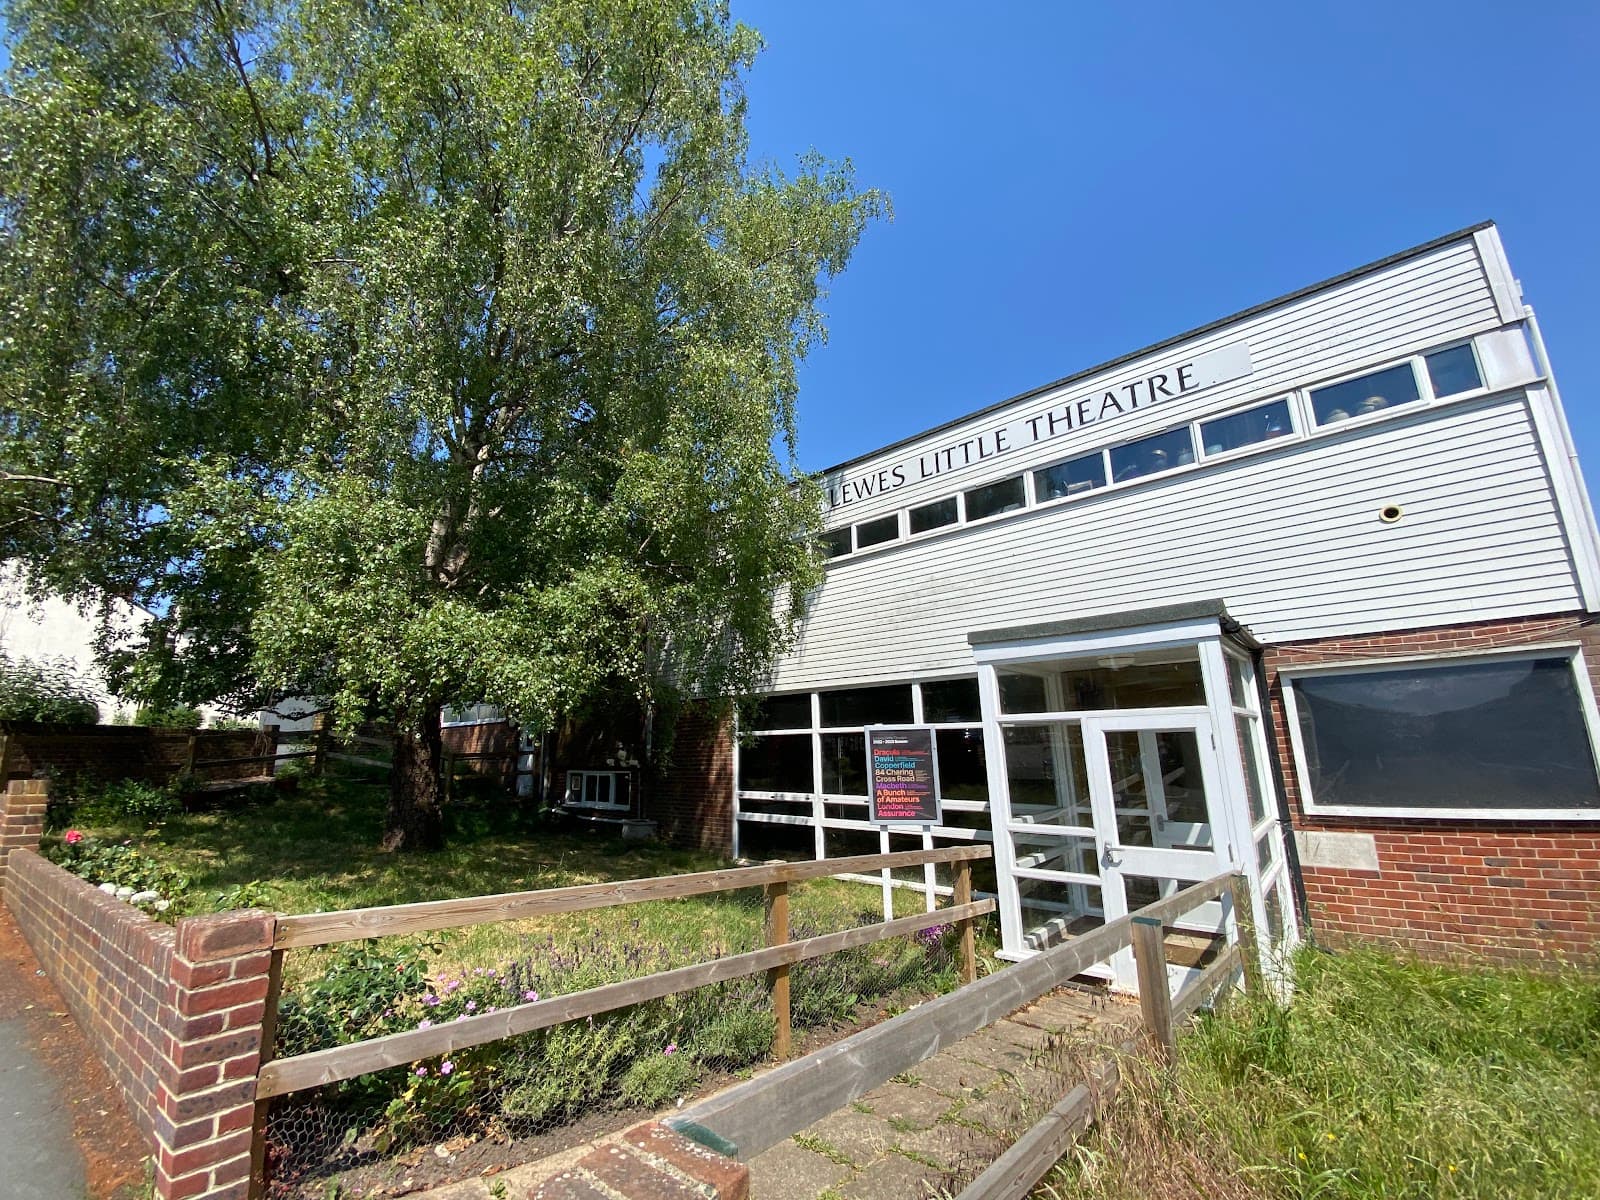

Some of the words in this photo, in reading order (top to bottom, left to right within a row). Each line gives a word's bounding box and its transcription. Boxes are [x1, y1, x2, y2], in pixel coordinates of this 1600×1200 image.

[830, 464, 906, 509] LEWES
[920, 430, 1011, 478] LITTLE
[1026, 363, 1199, 441] THEATRE
